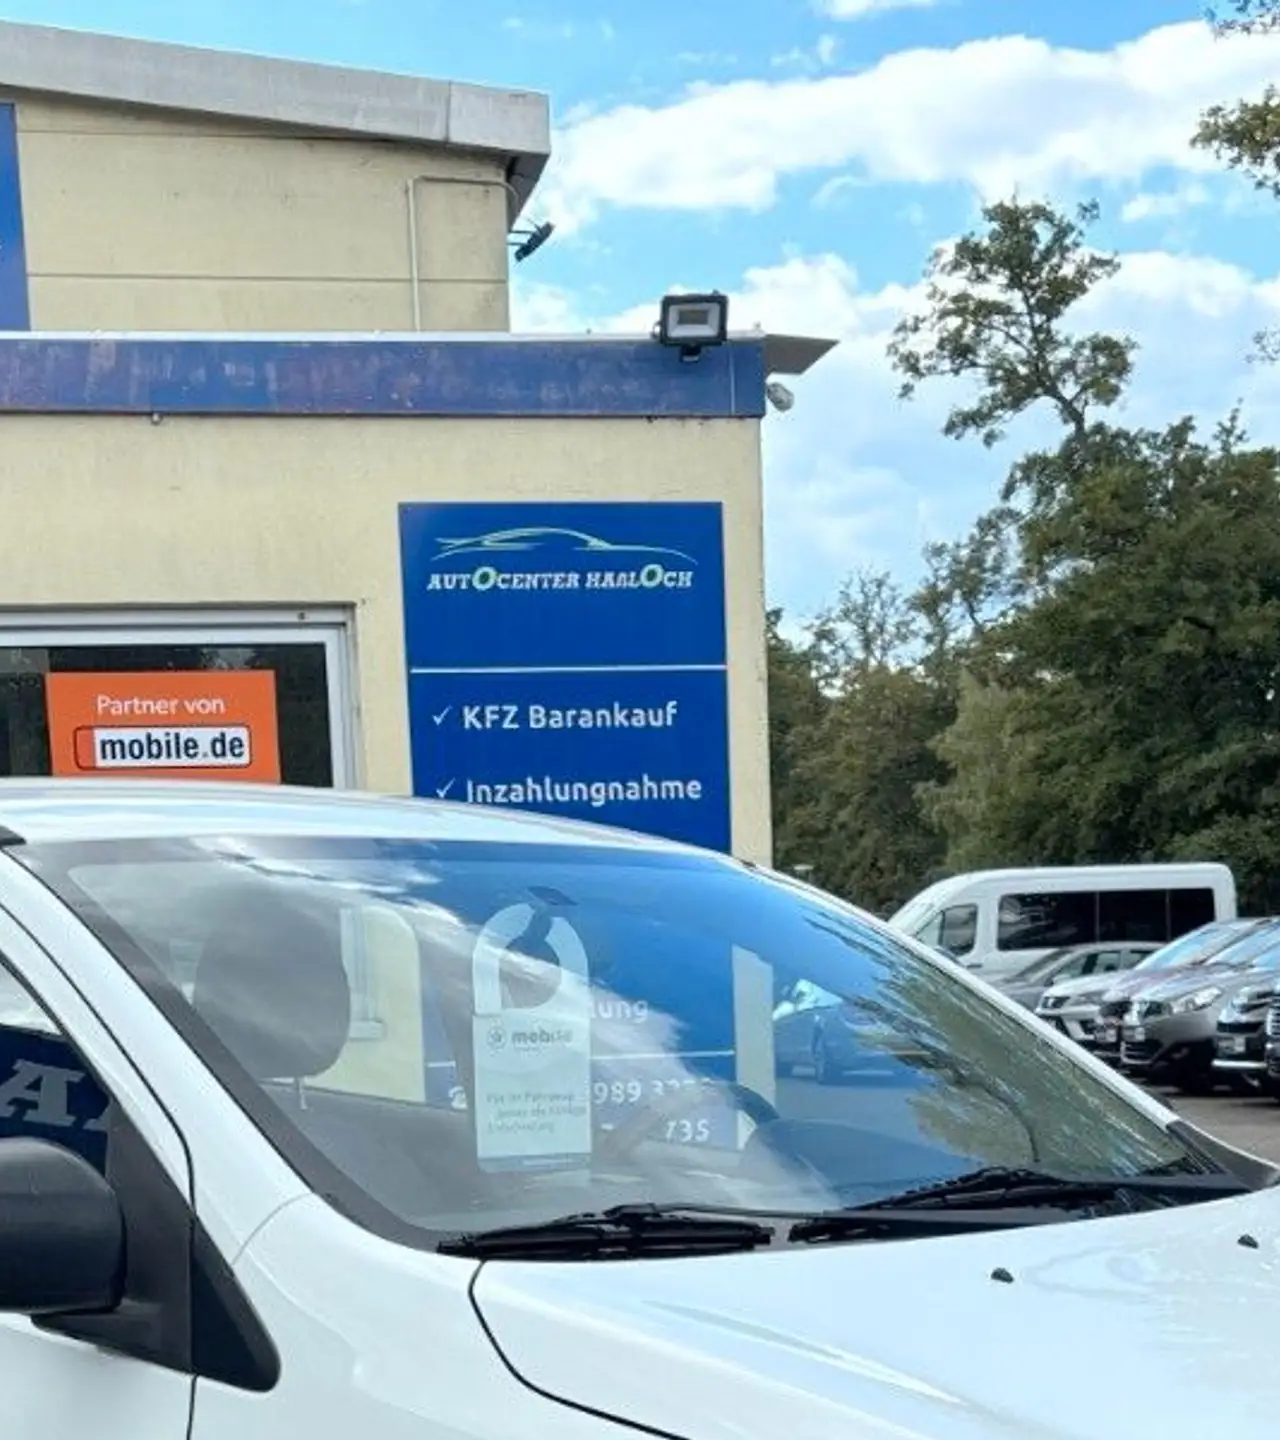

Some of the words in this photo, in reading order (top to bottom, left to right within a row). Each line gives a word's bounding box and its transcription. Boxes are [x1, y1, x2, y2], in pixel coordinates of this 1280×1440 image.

[426, 566, 580, 591] AUTOCENTER
[96, 693, 180, 716] Partner
[183, 697, 226, 715] von
[462, 704, 520, 730] KFZ
[528, 700, 678, 729] Barankauf
[99, 731, 245, 761] mobile.de
[466, 772, 703, 808] Inzahlungnahme
